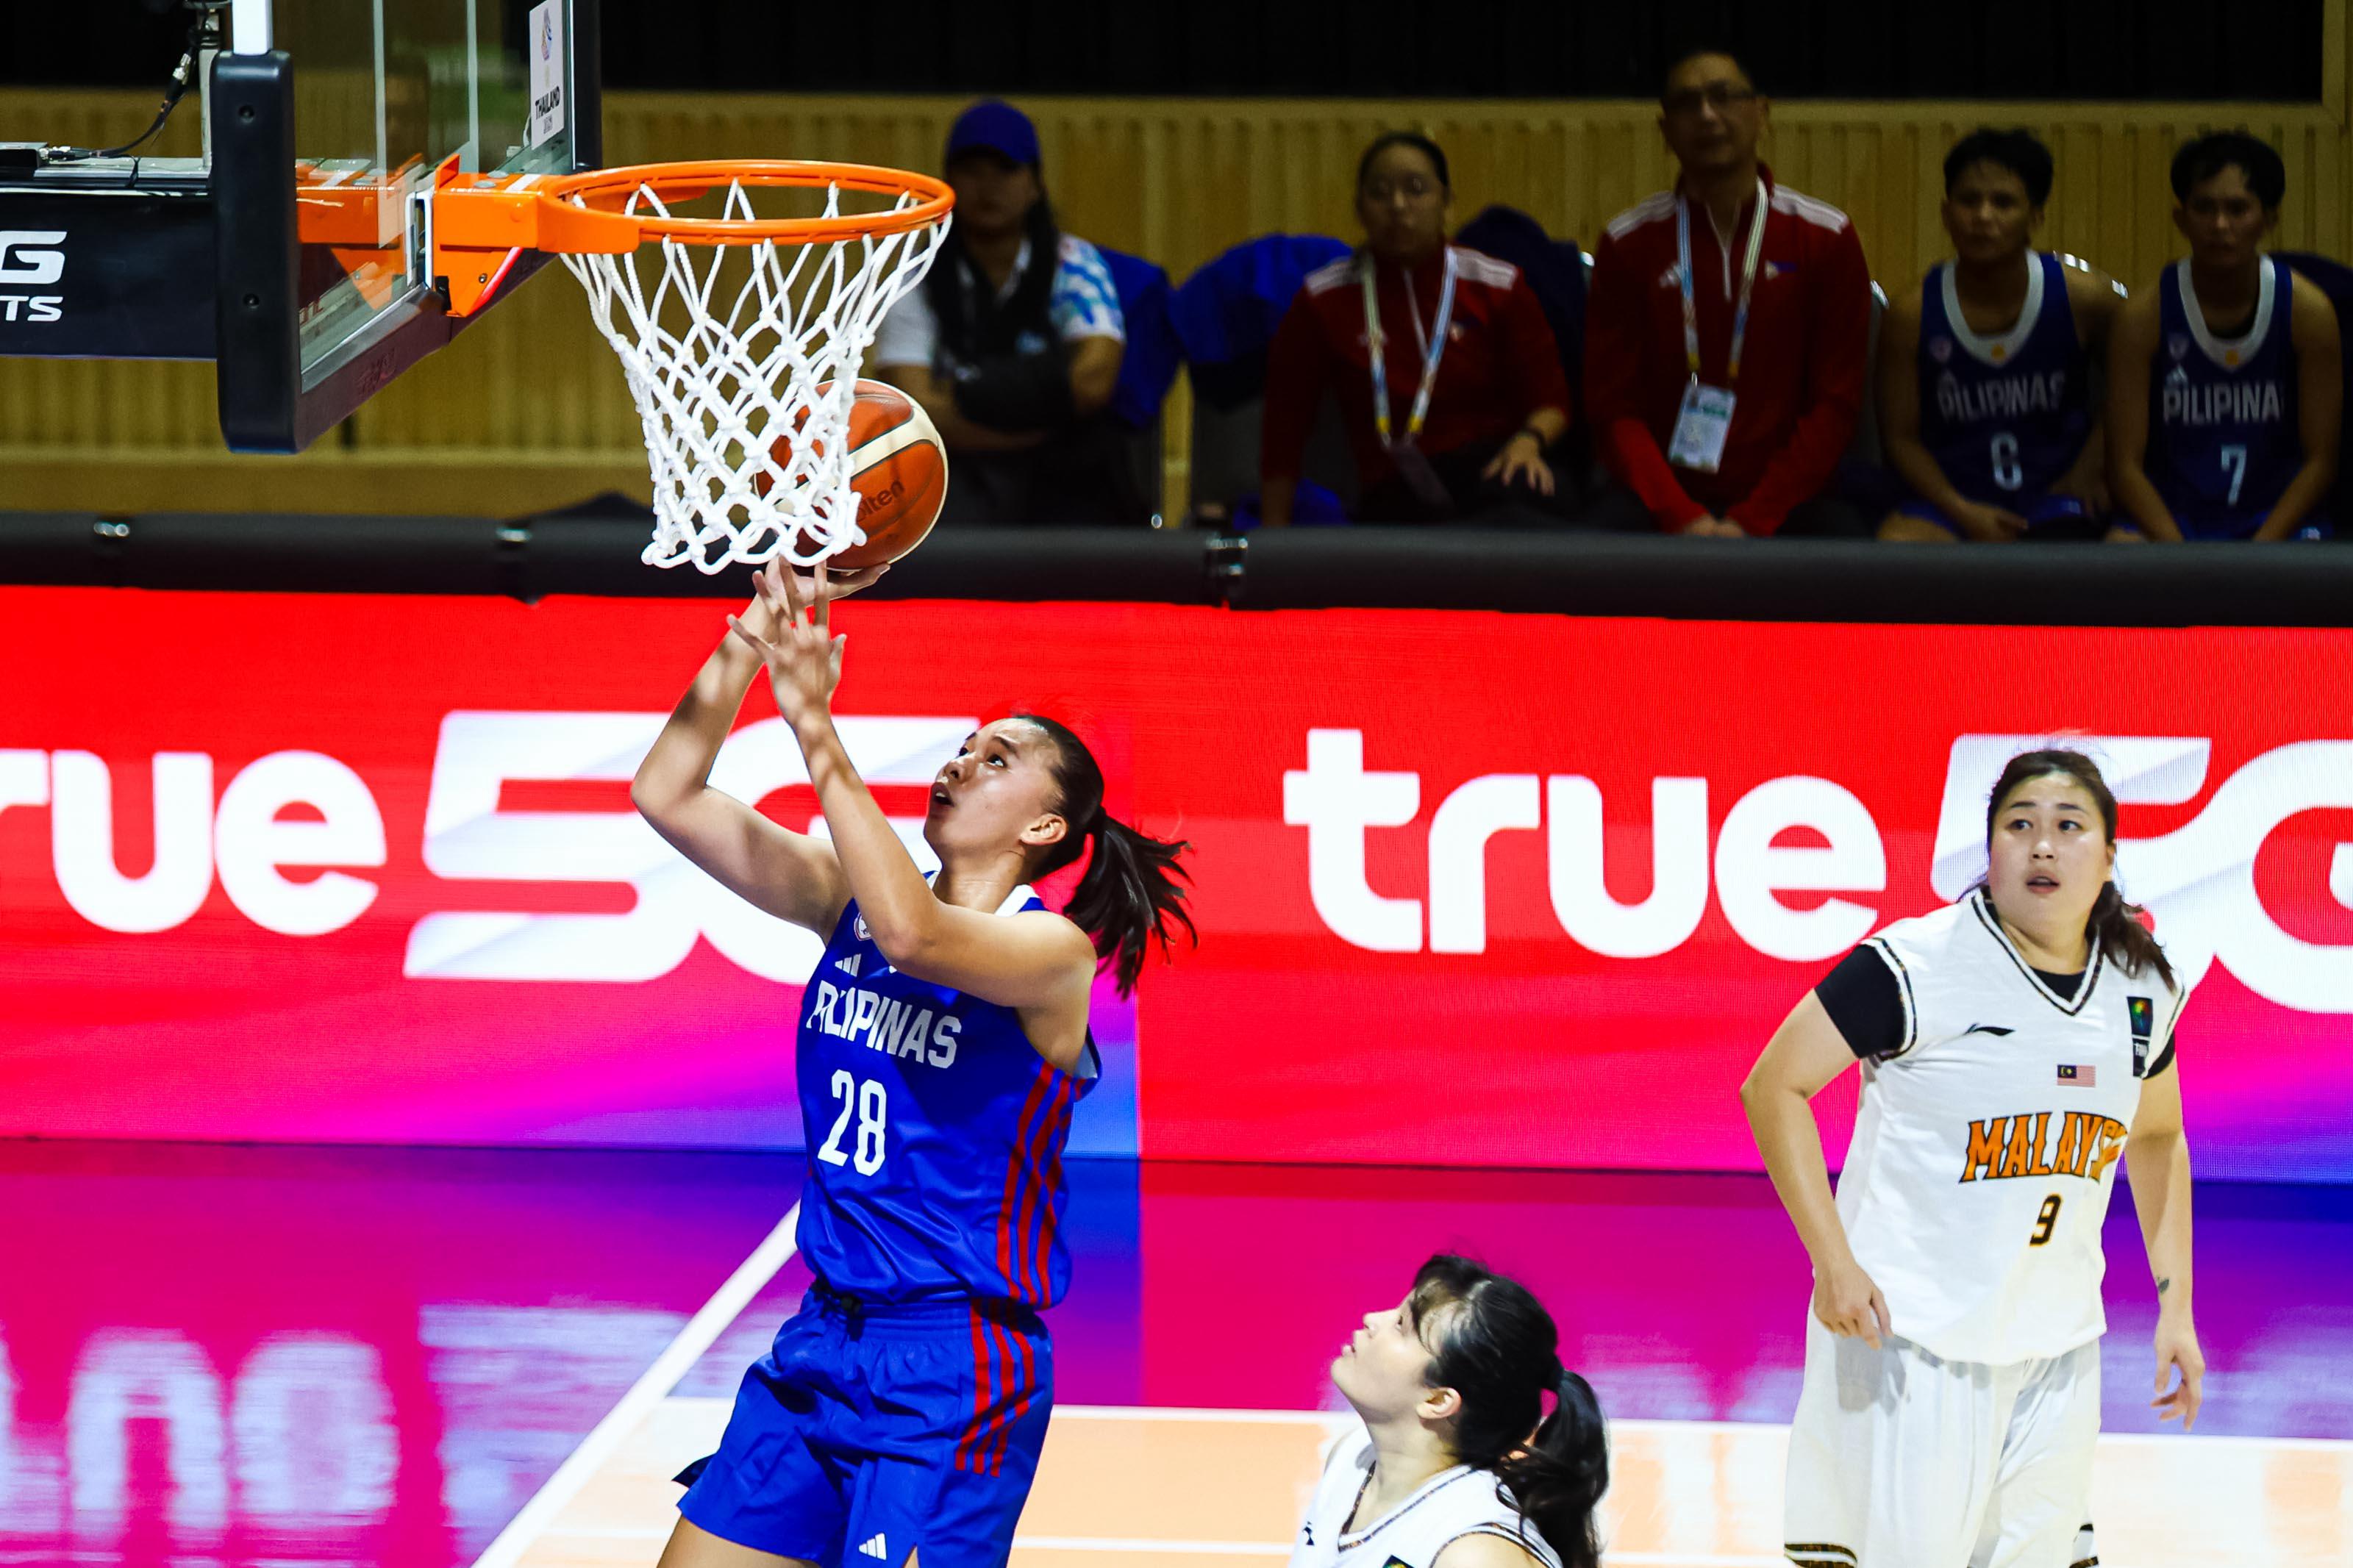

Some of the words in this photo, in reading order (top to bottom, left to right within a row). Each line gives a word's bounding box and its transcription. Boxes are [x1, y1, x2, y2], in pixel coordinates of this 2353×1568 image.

[2163, 381, 2285, 426] PILIPINA
[1990, 432, 2023, 492] 6
[2221, 445, 2247, 507] 7
[858, 480, 904, 522] olten
[1283, 728, 1887, 962] true
[818, 1069, 887, 1176] 28
[1959, 1111, 2128, 1184] MALAY
[2029, 1192, 2063, 1247] 9
